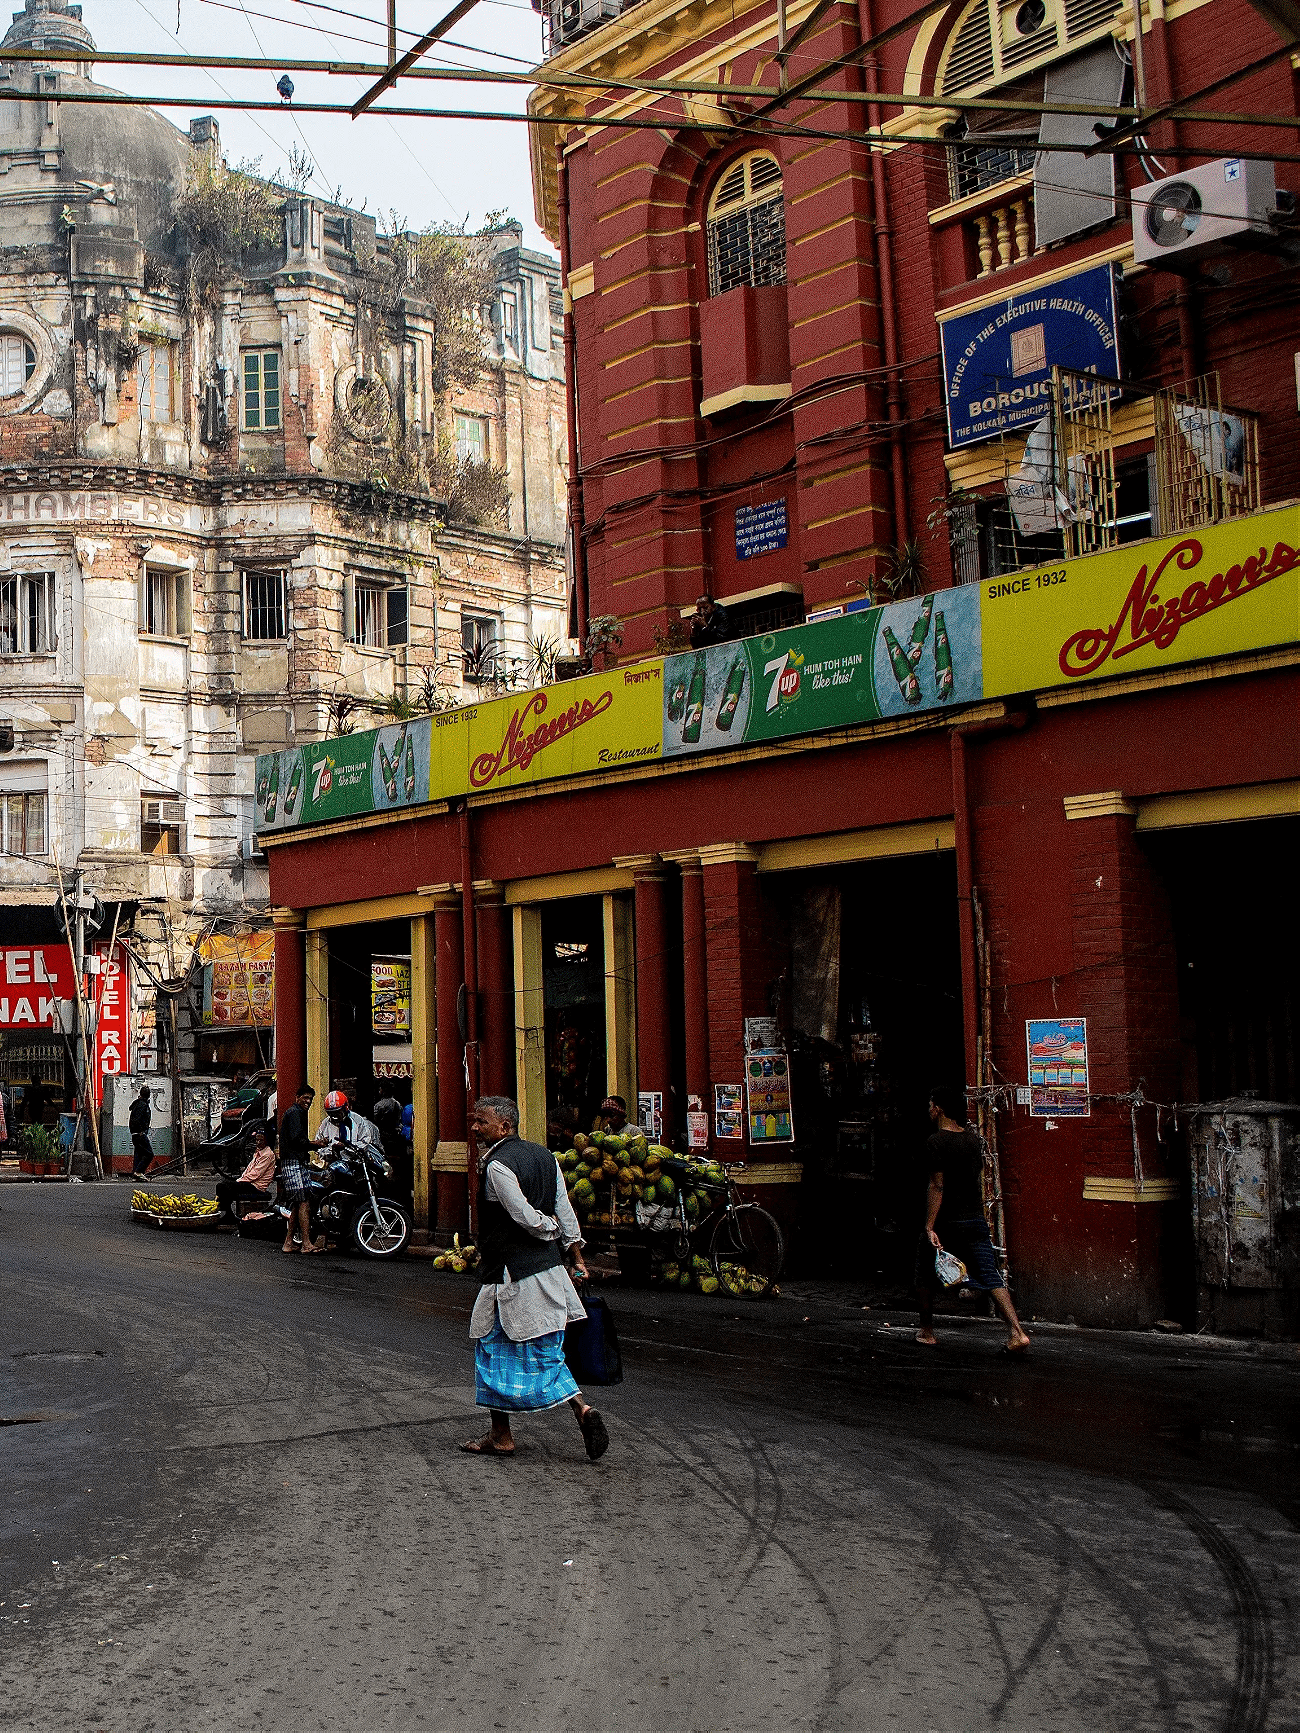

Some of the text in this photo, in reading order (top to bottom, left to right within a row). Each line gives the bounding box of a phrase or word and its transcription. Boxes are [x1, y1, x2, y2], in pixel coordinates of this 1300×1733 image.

[950, 298, 1114, 398] OFFICE OF THE EXECUTIVE HEALTH OFFICER
[955, 402, 1052, 438] THE KOLKATA MUNICIPA
[988, 570, 1067, 599] SINCE 1932
[803, 654, 862, 675] HUM TOH HAIN
[812, 667, 855, 690] like this!
[435, 709, 478, 728] SINCE 1932
[597, 742, 660, 765] Restaurant
[100, 946, 121, 1074] HOTEL RAU
